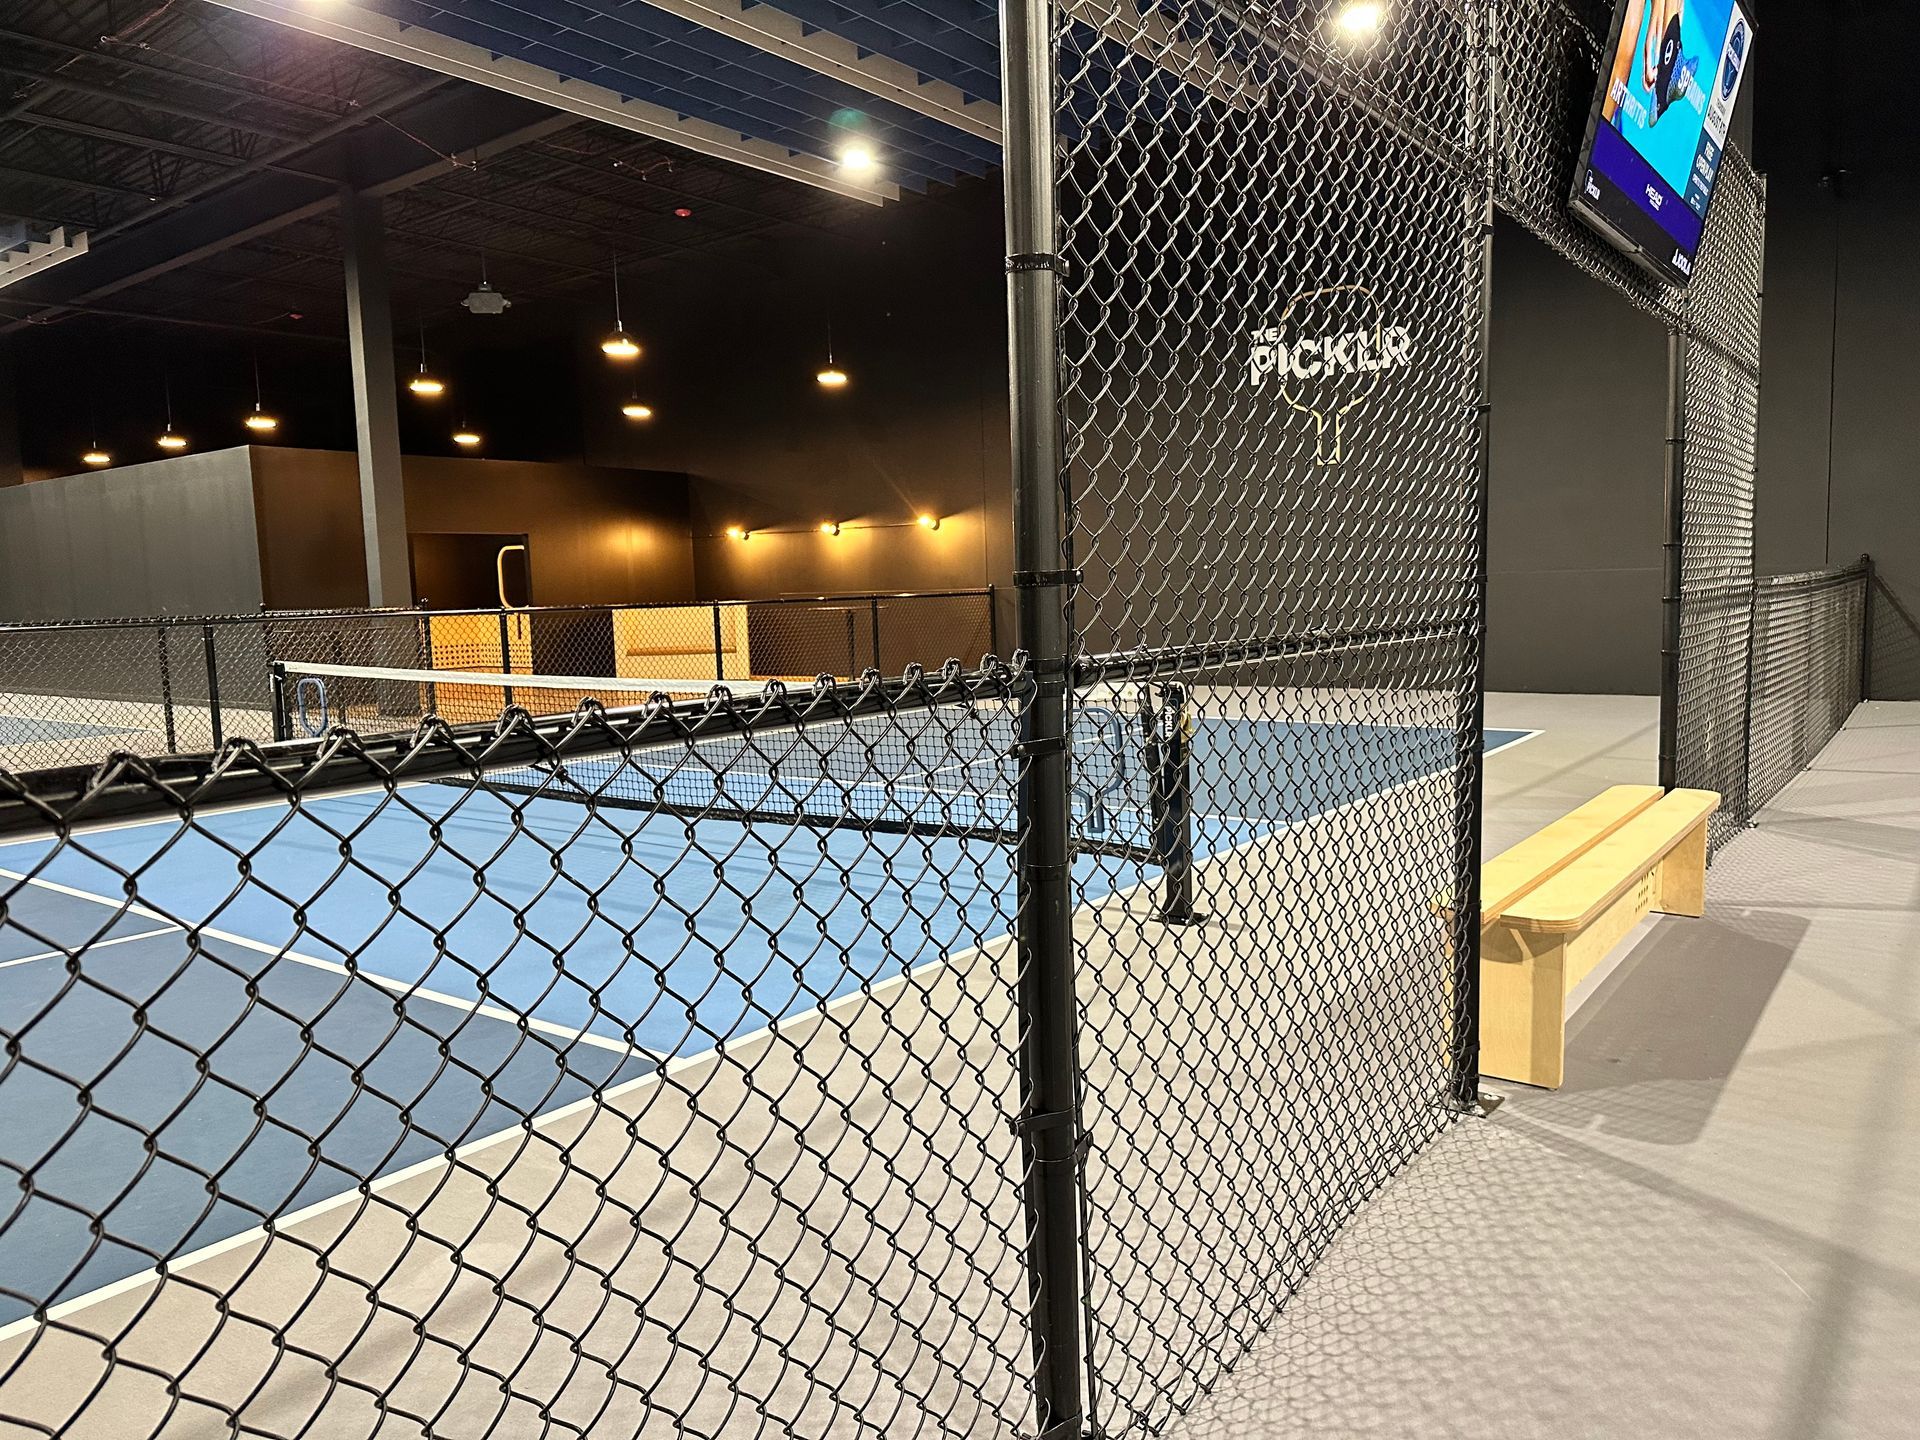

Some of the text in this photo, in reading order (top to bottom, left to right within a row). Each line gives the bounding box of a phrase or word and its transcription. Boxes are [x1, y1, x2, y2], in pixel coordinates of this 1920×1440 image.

[1610, 77, 1647, 129] ARTHRITIS
[1678, 66, 1706, 115] SPRAINS
[1645, 183, 1663, 206] HEAD
[1250, 327, 1279, 344] THE
[1250, 326, 1412, 386] PICKLR
[1164, 705, 1175, 738] PICKLR
